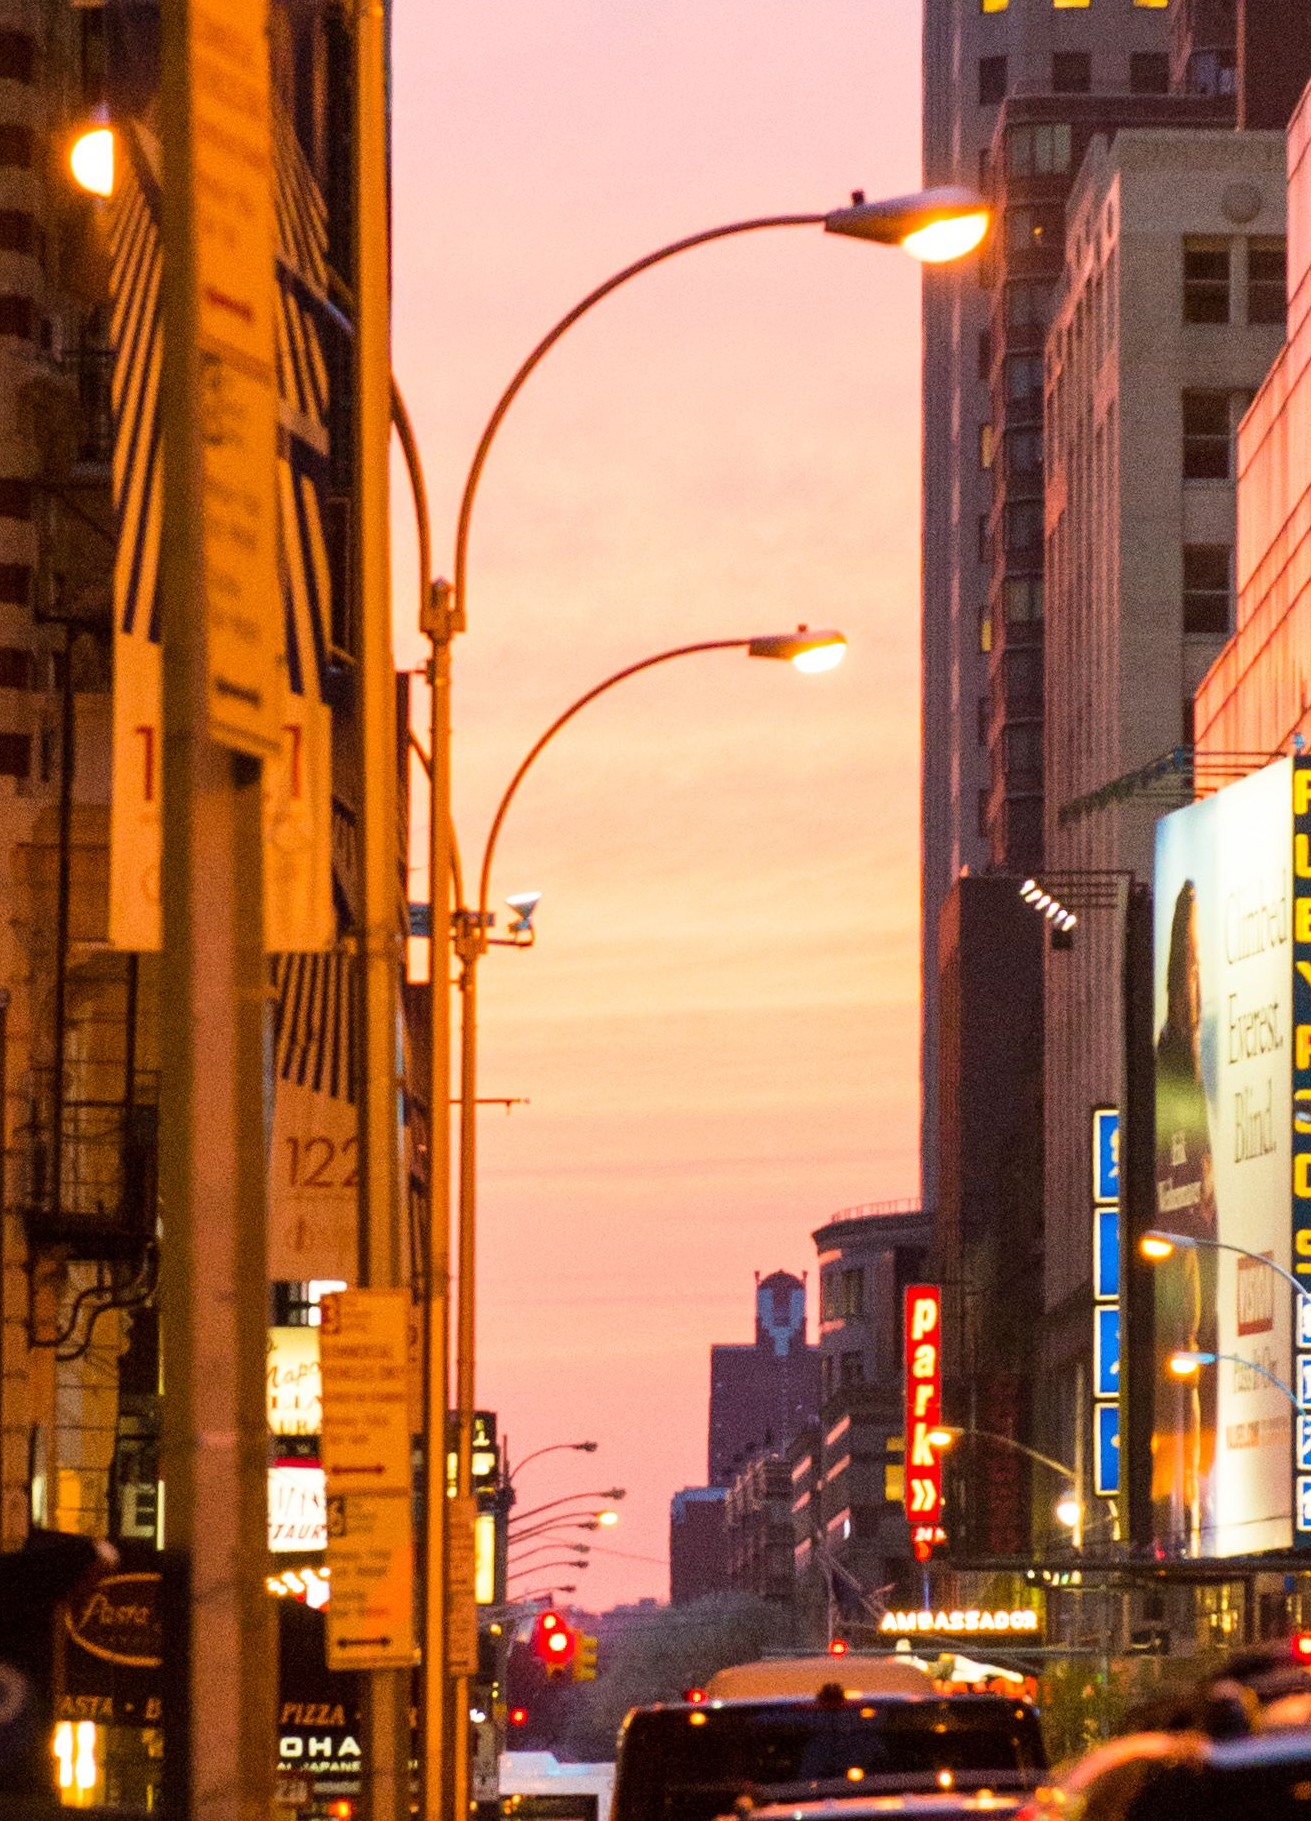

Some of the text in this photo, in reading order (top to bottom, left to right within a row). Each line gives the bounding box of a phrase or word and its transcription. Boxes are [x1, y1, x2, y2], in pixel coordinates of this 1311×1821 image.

[912, 1298, 937, 1466] park
[882, 1612, 1037, 1632] AMBASSADOR
[58, 1697, 111, 1717] ASTA
[279, 1703, 346, 1726] PIZZA
[279, 1736, 361, 1758] OHA
